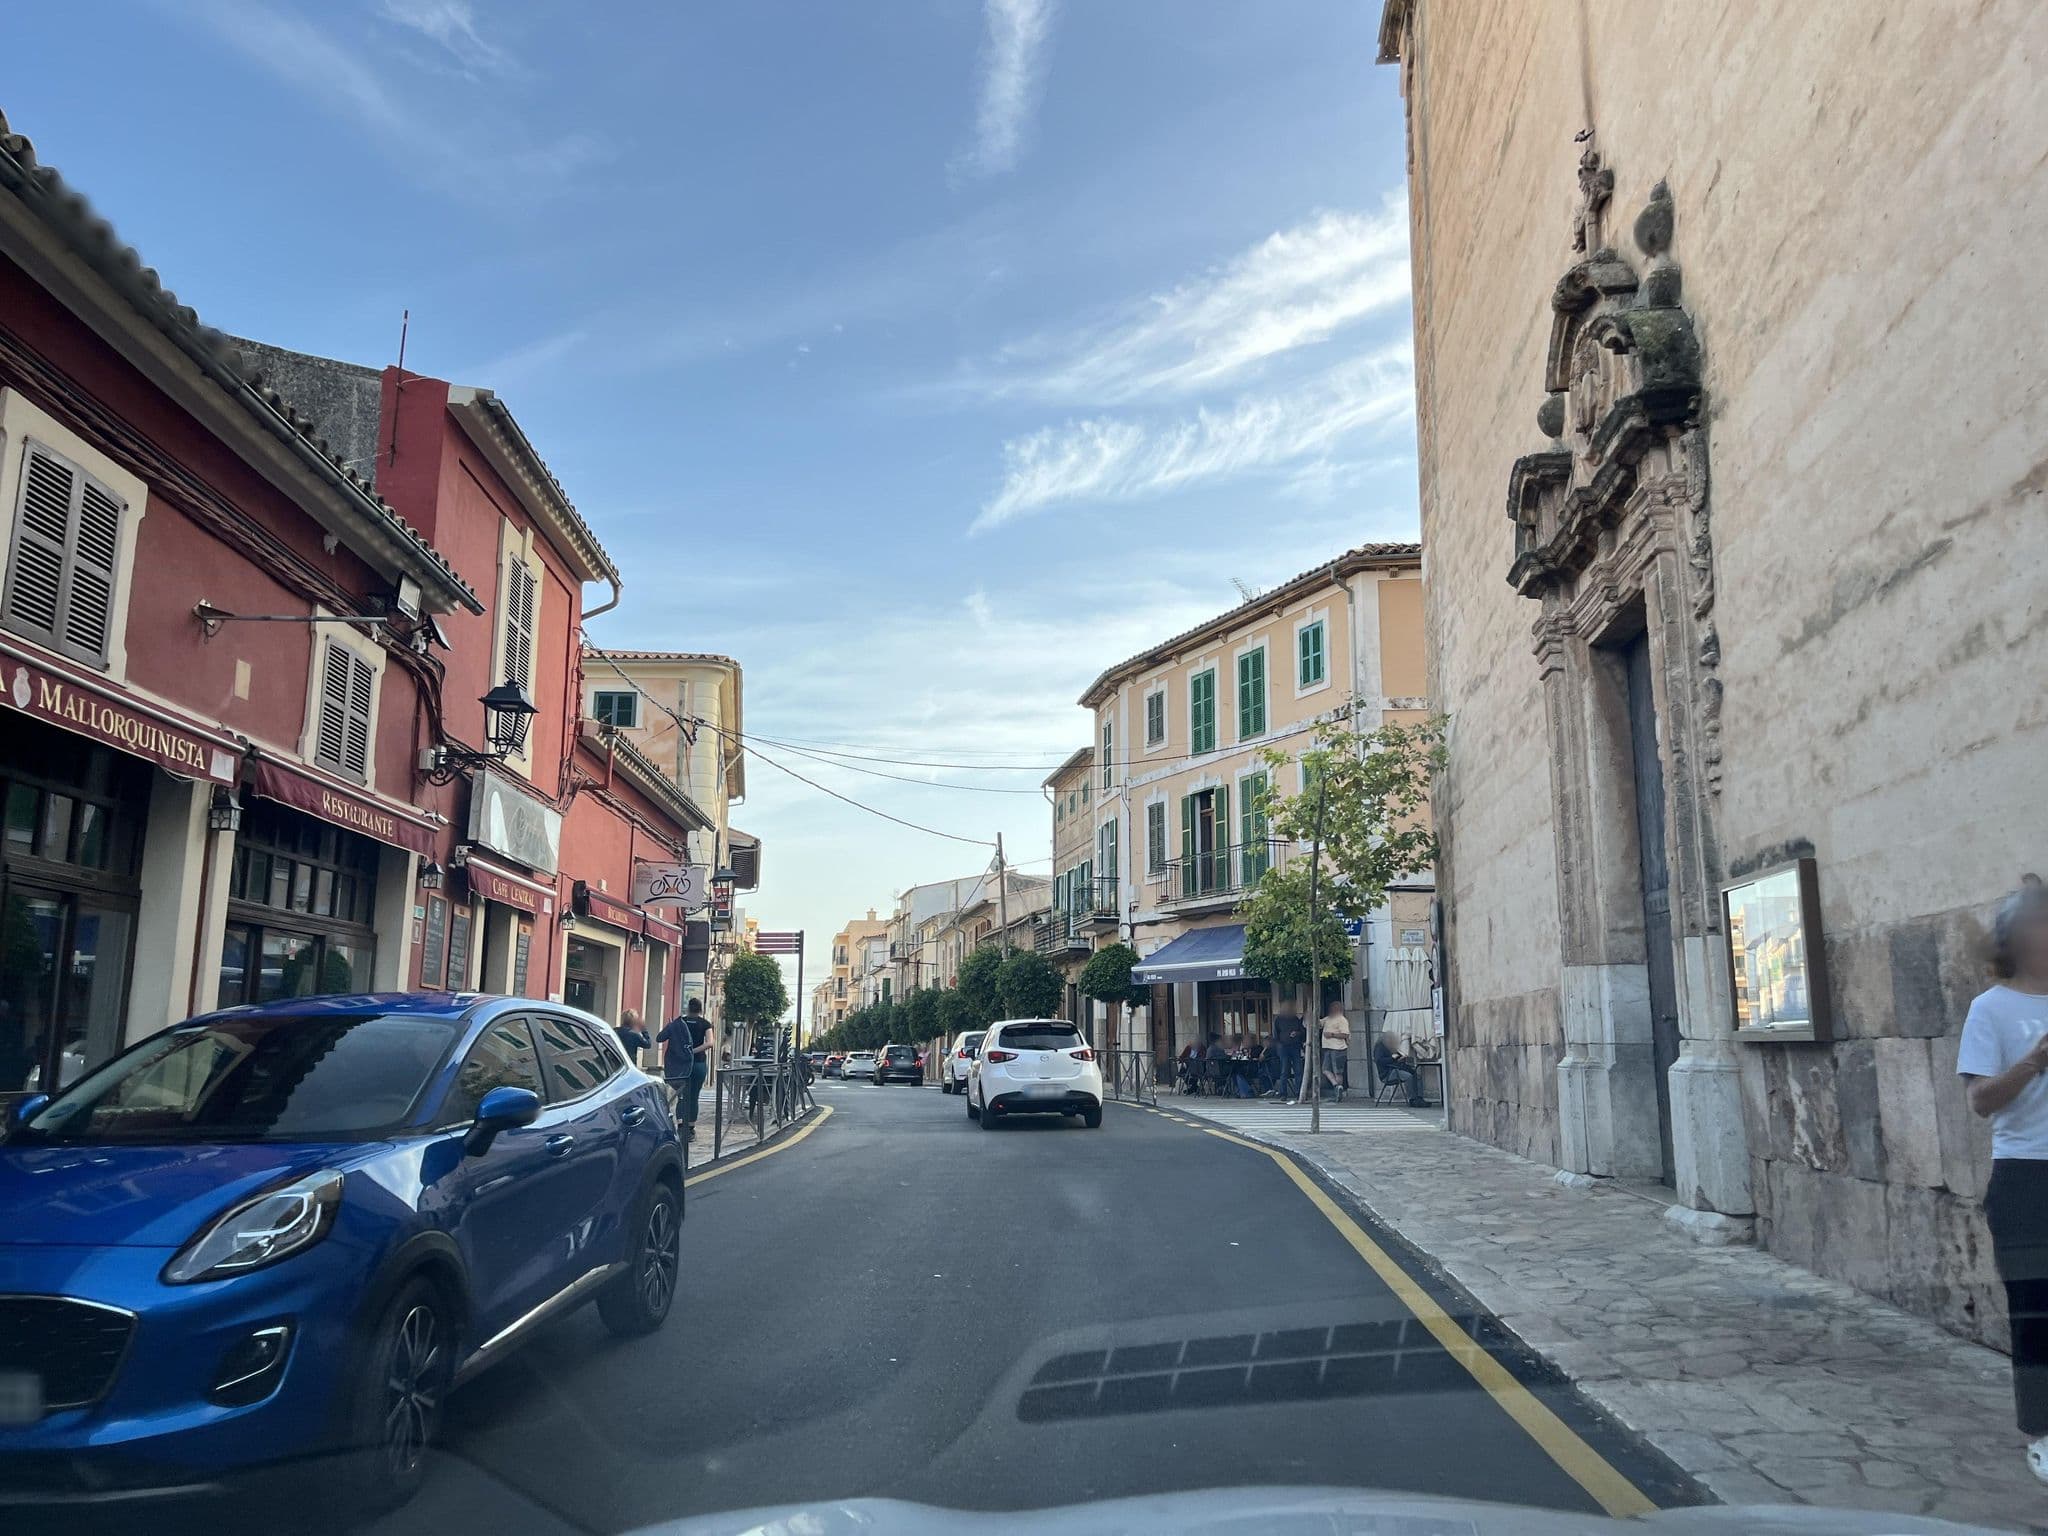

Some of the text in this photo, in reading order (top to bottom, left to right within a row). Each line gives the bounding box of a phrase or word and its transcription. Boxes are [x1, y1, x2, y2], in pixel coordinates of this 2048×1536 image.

[38, 677, 206, 770] MALLORQUINISTA
[322, 790, 394, 837] RESTAURANTE
[511, 885, 536, 907] CENTRAL
